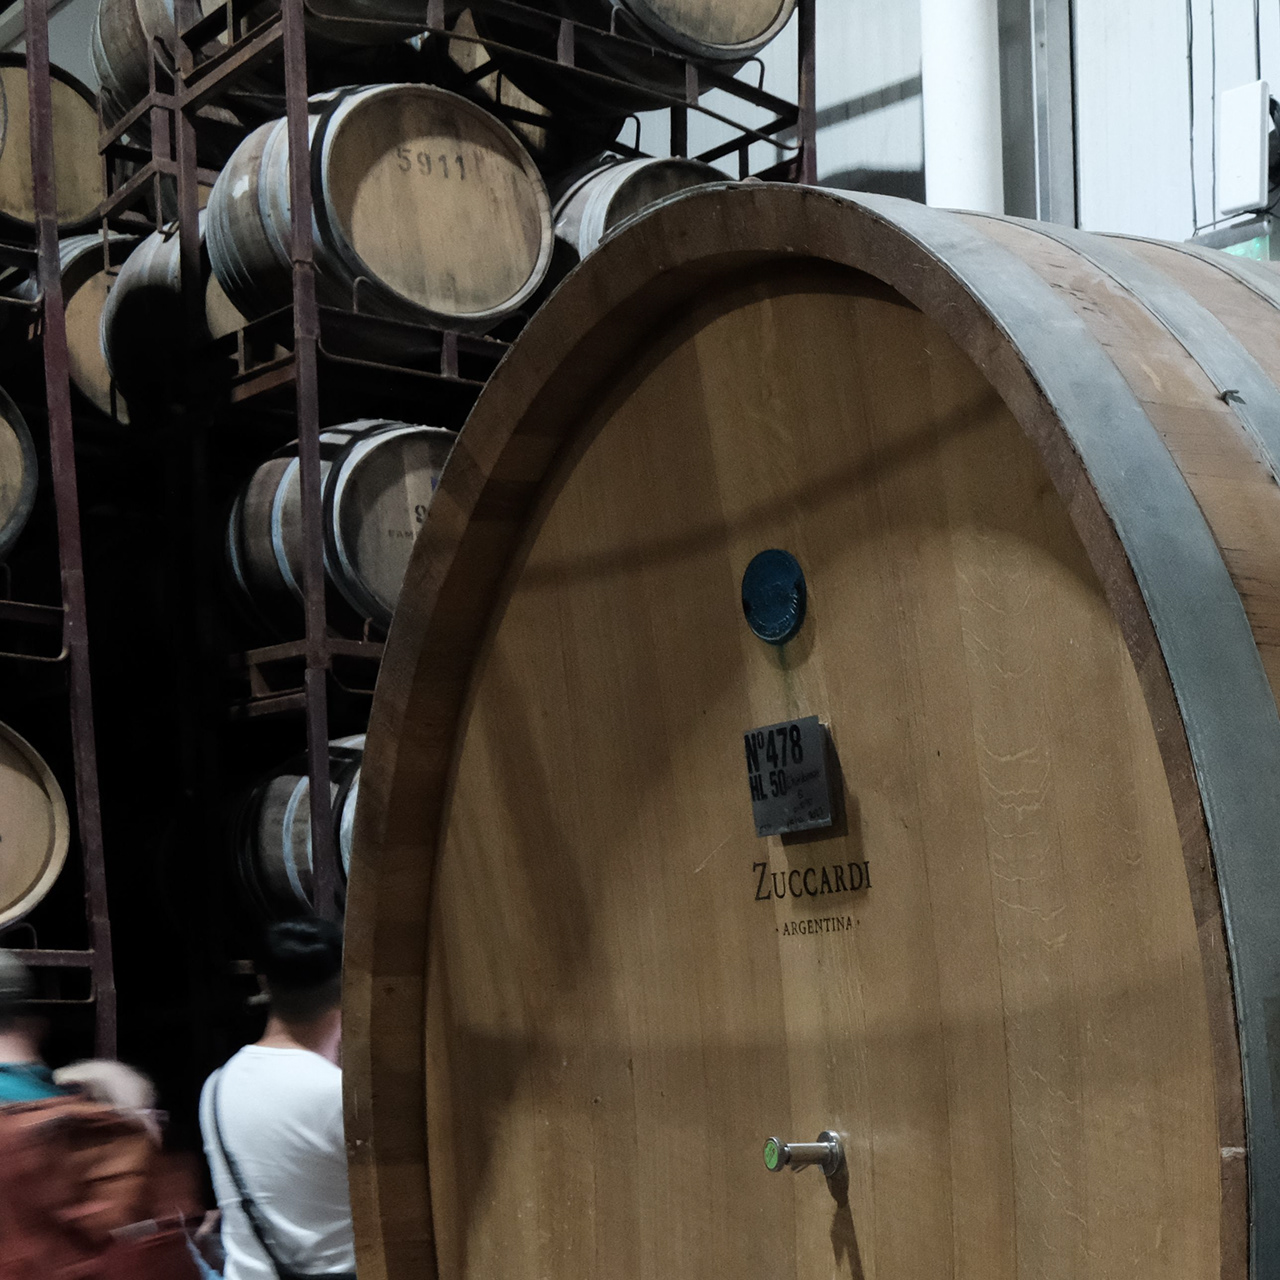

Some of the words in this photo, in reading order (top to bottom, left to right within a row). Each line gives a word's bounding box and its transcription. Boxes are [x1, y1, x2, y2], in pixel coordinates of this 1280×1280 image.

[397, 146, 466, 181] 5911
[749, 774, 768, 802] HL
[769, 769, 787, 797] 50
[752, 861, 873, 901] ZUCCARDI
[783, 916, 852, 936] ARGENTINA
